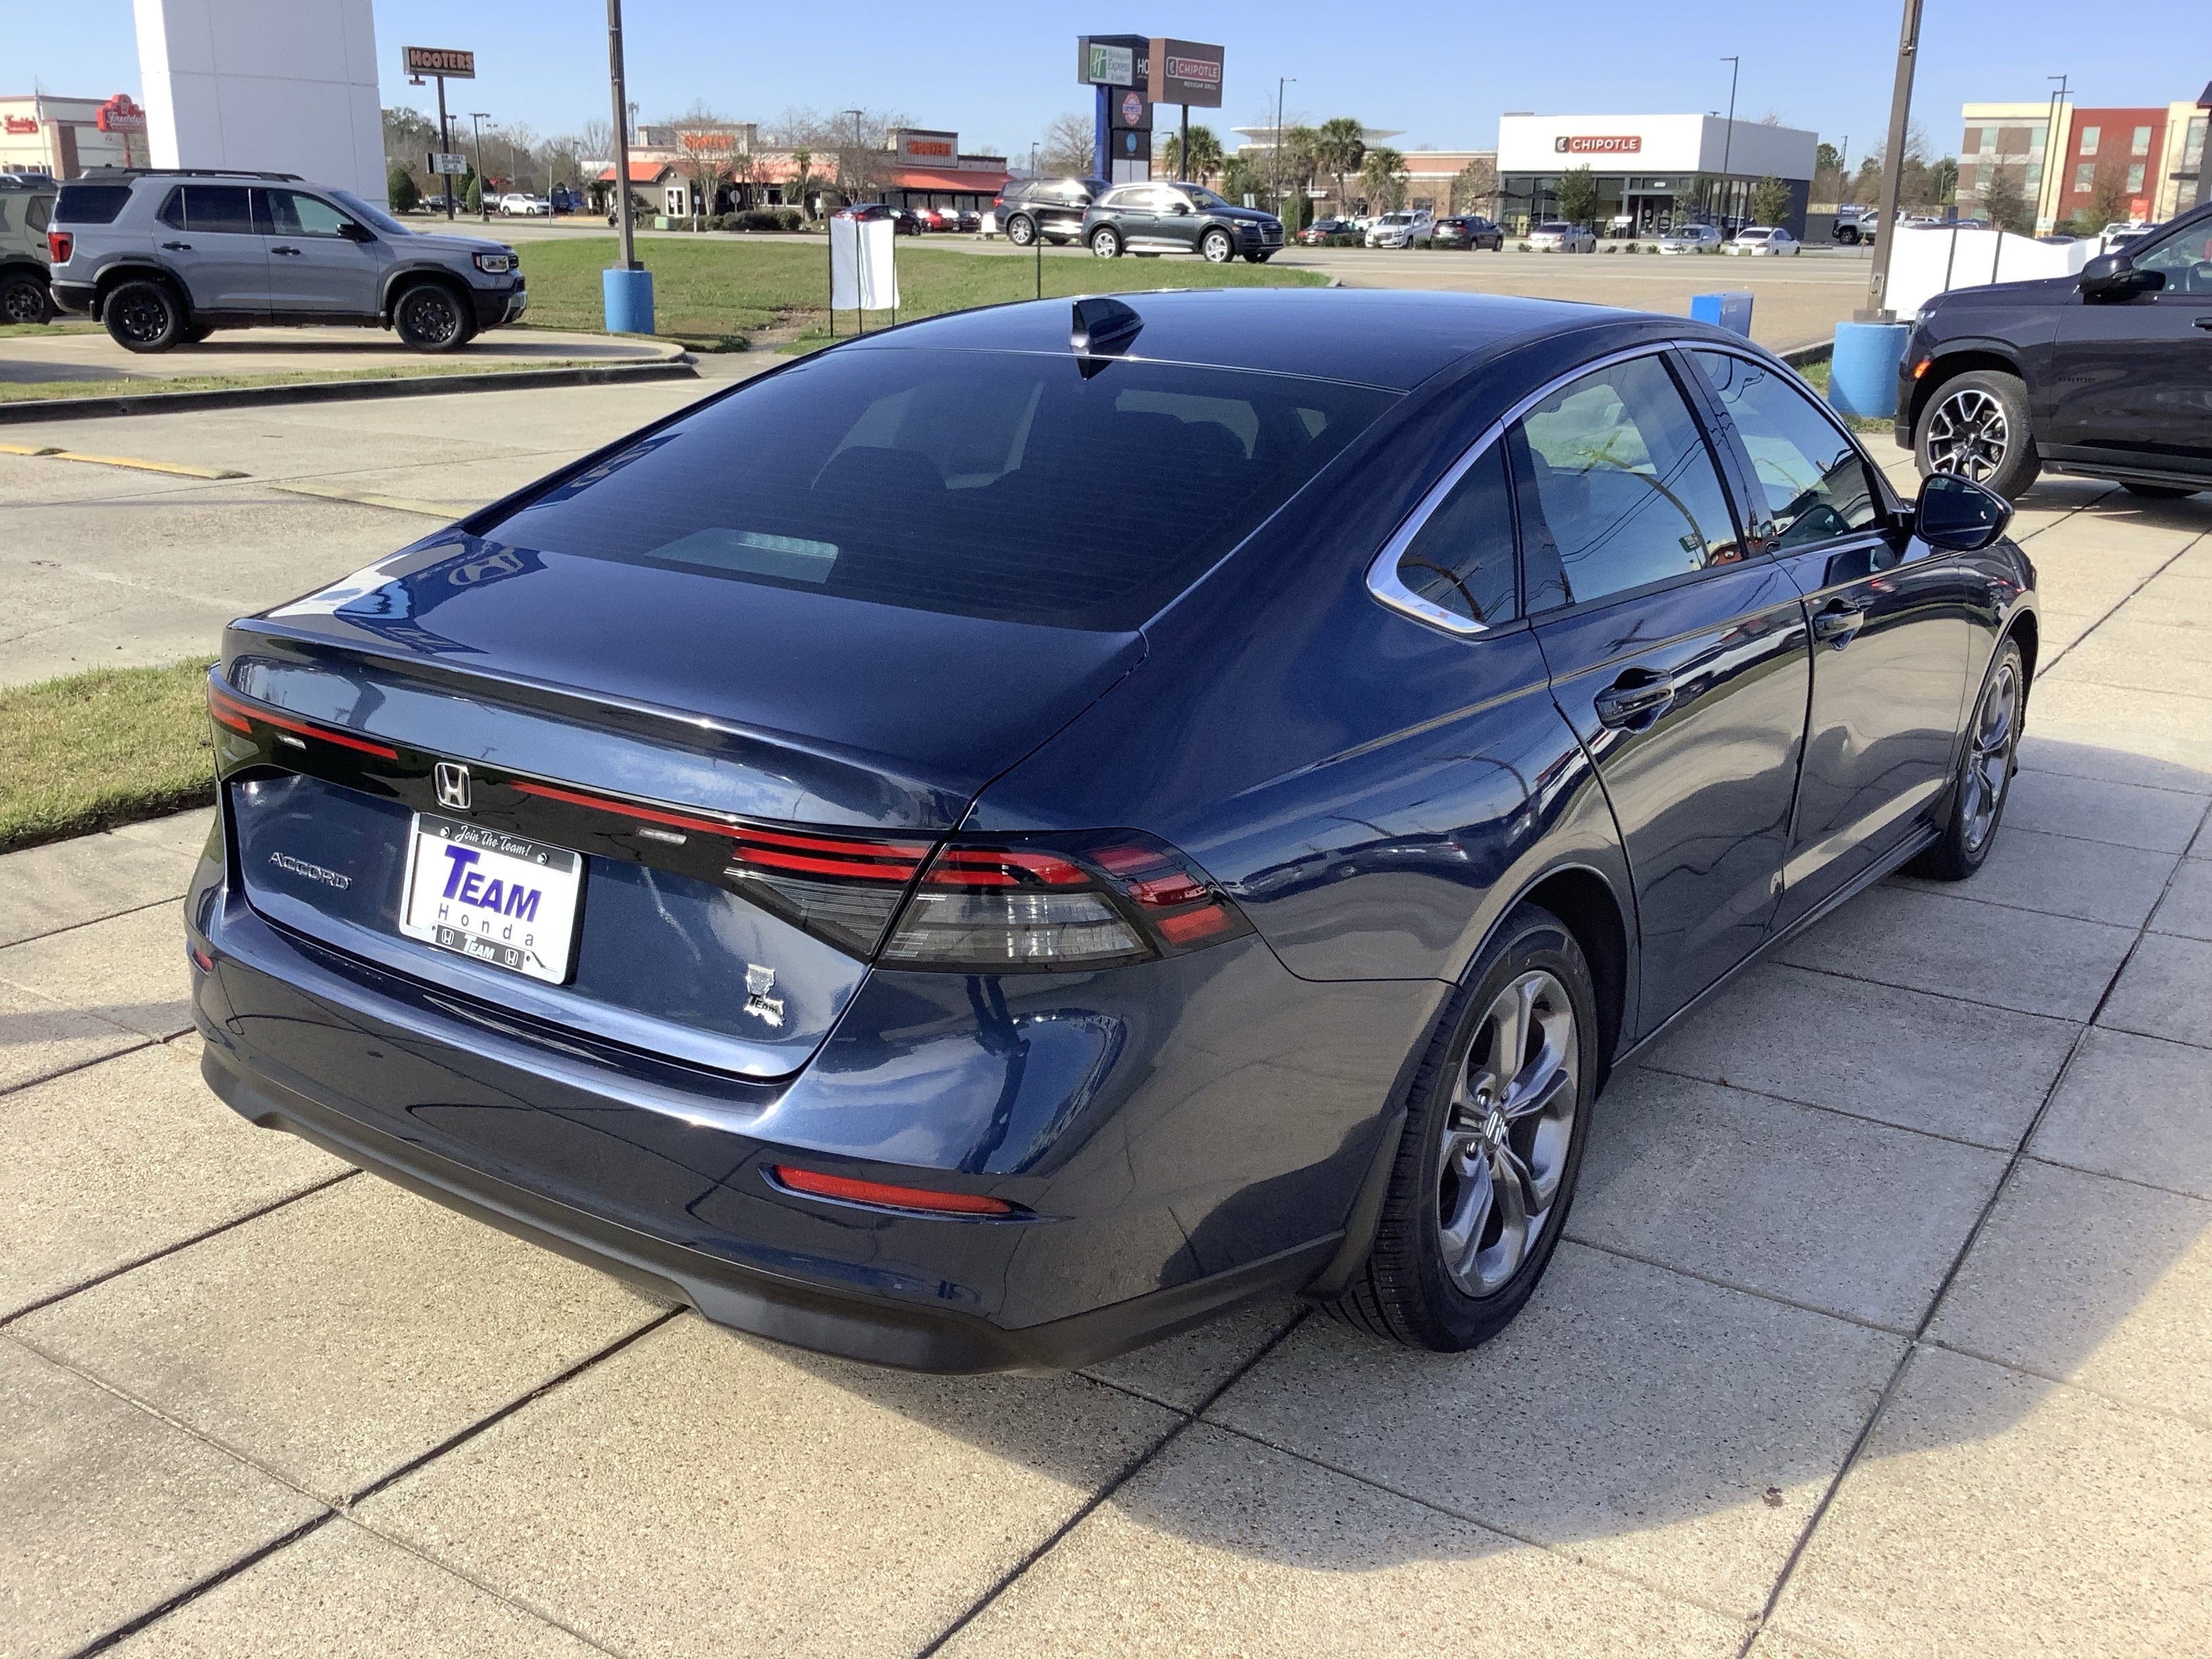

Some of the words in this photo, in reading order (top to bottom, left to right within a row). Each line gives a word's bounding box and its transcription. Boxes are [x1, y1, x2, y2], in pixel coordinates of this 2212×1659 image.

[410, 49, 474, 70] HOOTERS
[1107, 58, 1131, 73] Express
[1179, 63, 1218, 78] CHIPOTLE
[1572, 138, 1637, 150] CHIPOTLE
[455, 825, 479, 842] Join
[480, 830, 498, 847] The
[499, 835, 533, 857] Team!
[268, 852, 352, 890] ACCORD
[442, 844, 542, 922] TEAM
[438, 903, 534, 947] Honda
[463, 933, 495, 960] TEAM
